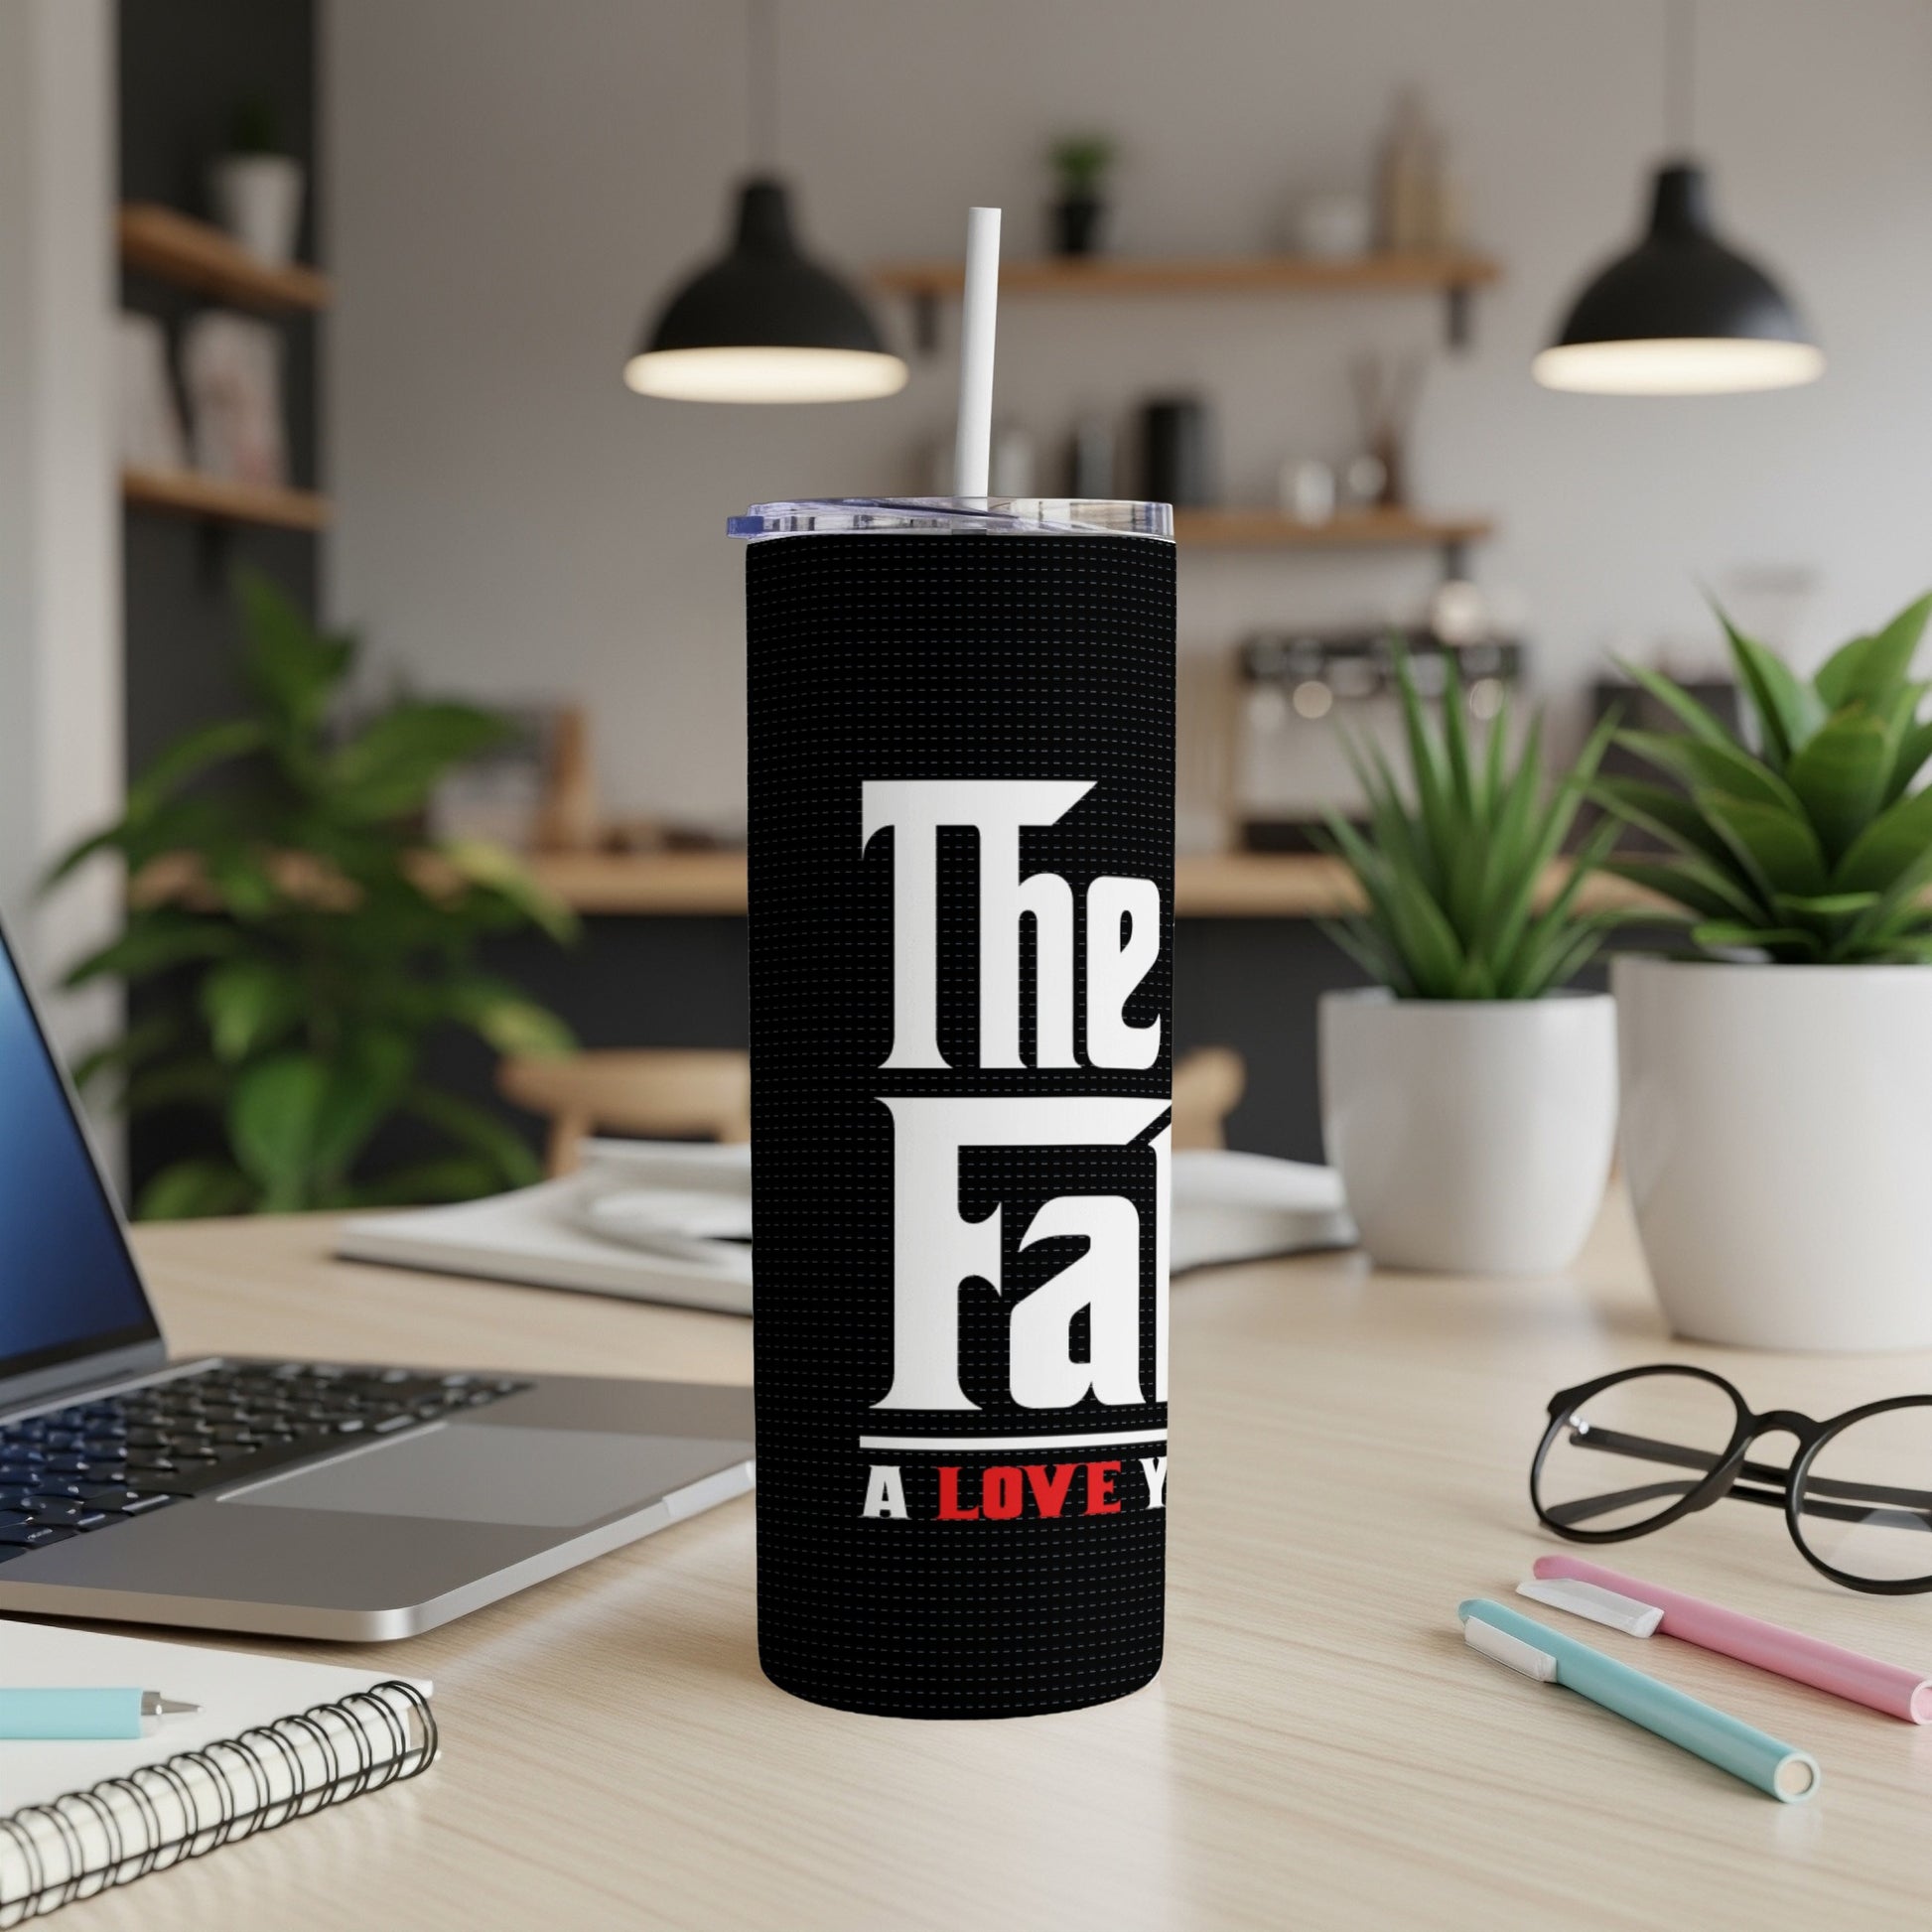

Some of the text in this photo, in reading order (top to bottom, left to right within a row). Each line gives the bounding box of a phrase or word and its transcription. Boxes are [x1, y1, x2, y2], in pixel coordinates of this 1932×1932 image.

[862, 779, 1162, 1070] The
[862, 1464, 910, 1519] A
[936, 1460, 1122, 1521] LOVE
